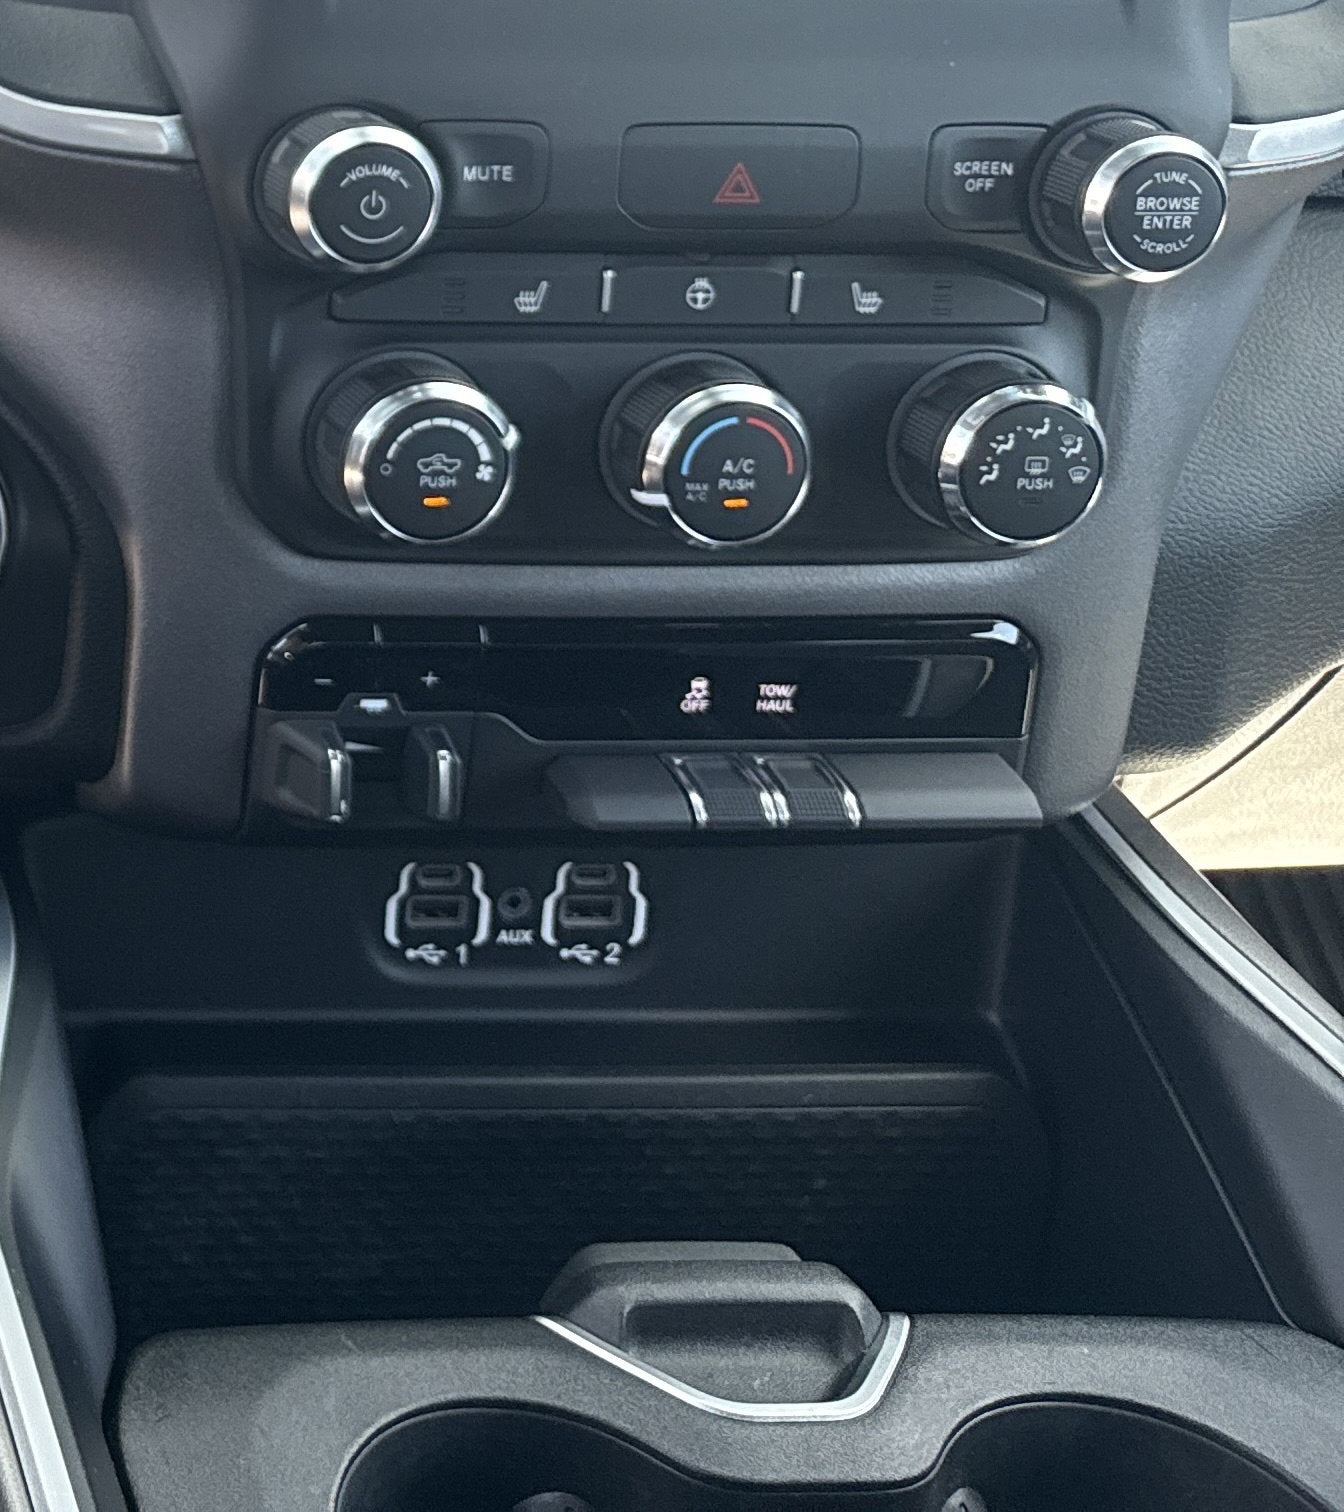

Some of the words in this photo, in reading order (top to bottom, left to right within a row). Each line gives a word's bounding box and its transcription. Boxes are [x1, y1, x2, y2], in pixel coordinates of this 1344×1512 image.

[346, 163, 402, 183] VOLUME
[463, 165, 513, 182] MUTE
[953, 161, 1013, 176] SCREEN
[964, 177, 995, 193] OFF
[1153, 171, 1188, 184] TUNE
[1136, 196, 1200, 210] BROWSE
[1142, 215, 1192, 229] ENTER
[1140, 238, 1189, 254] SCROLL
[722, 458, 755, 474] A/C
[419, 476, 457, 488] PUSH
[718, 478, 755, 490] PUSH
[1016, 477, 1053, 490] PUSH
[680, 699, 710, 713] OFF
[755, 699, 795, 713] HAUL
[496, 929, 535, 945] AUX
[455, 943, 468, 965] 1
[603, 942, 622, 965] 2
